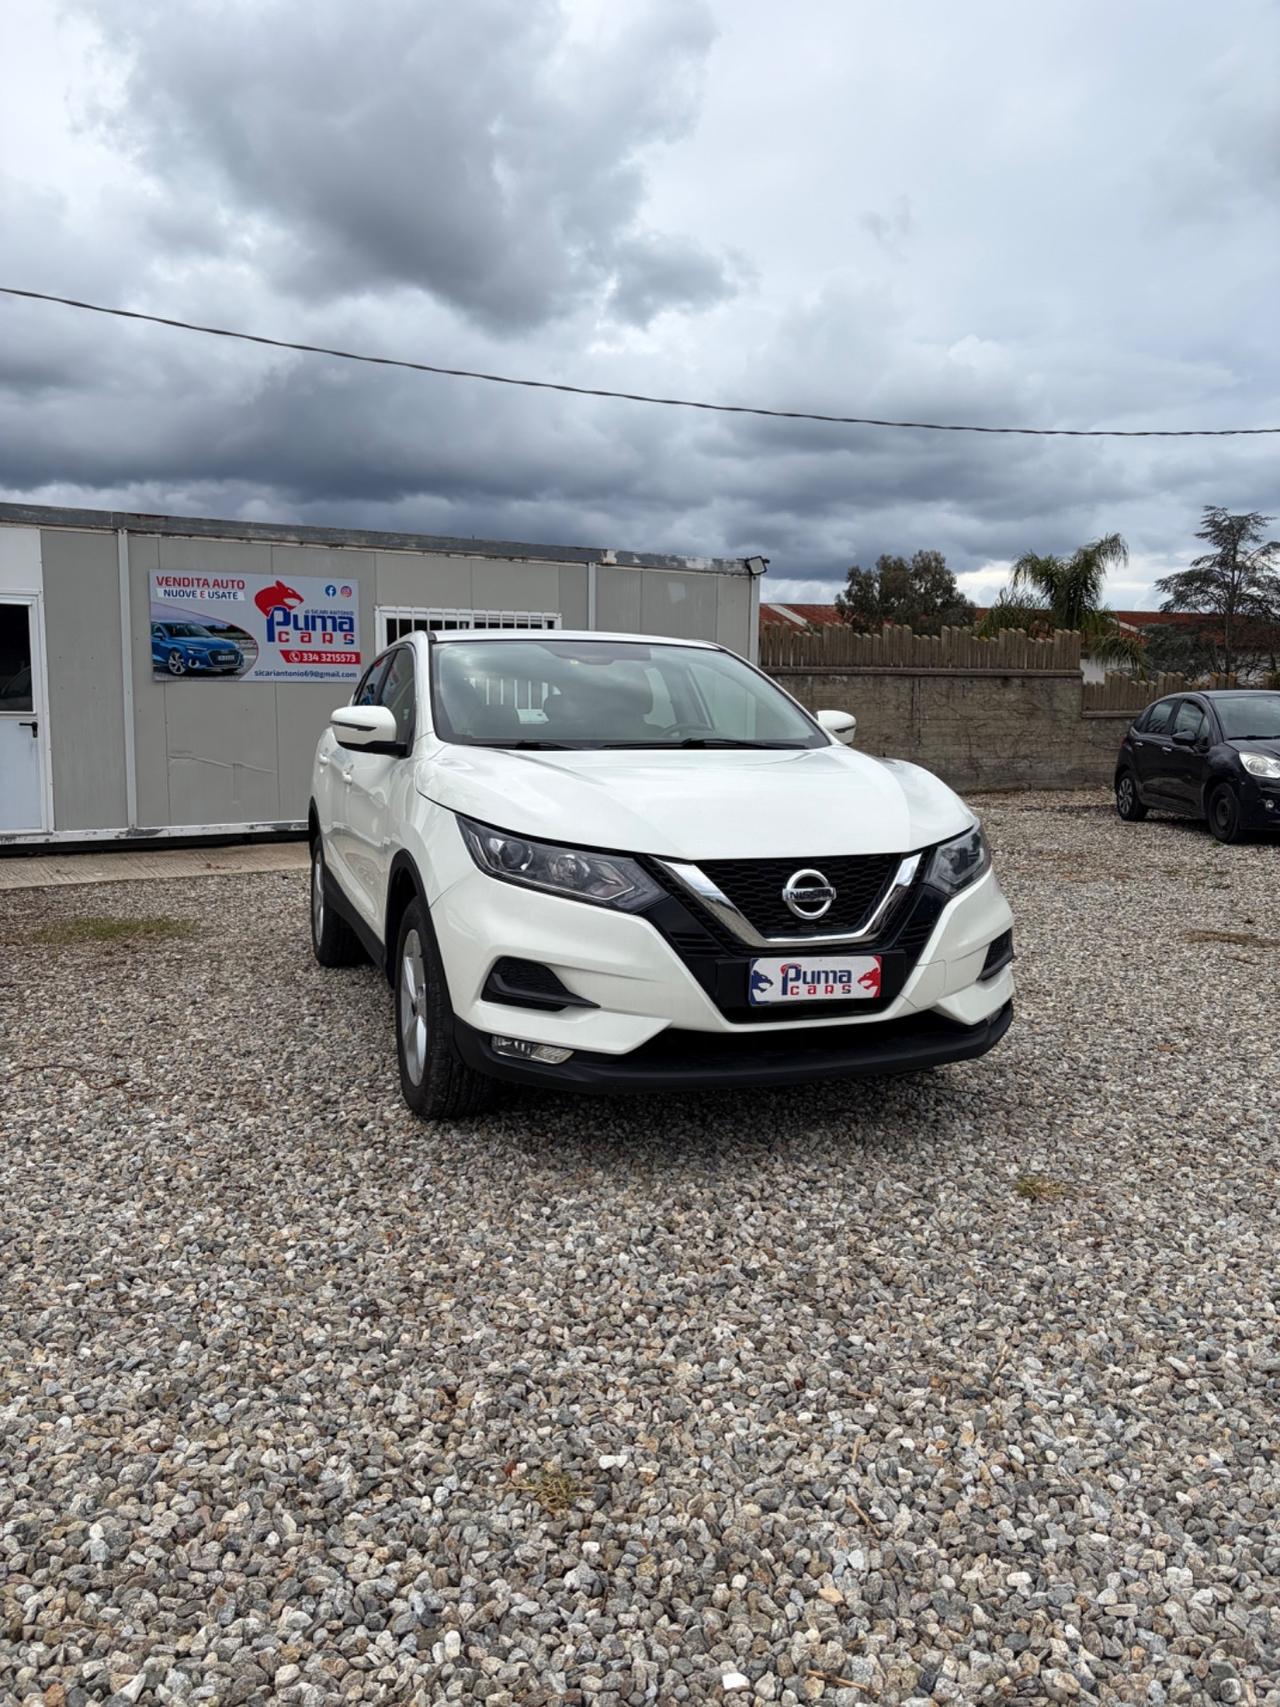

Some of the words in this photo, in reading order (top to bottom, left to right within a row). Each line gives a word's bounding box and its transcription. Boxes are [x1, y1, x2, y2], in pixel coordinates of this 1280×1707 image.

[156, 576, 210, 588] VENDITA
[212, 578, 245, 590] AUTO
[163, 589, 197, 598] NUOVE
[199, 591, 206, 599] E
[207, 591, 239, 600] USATE
[302, 653, 319, 662] 334
[321, 653, 356, 663] 3215573
